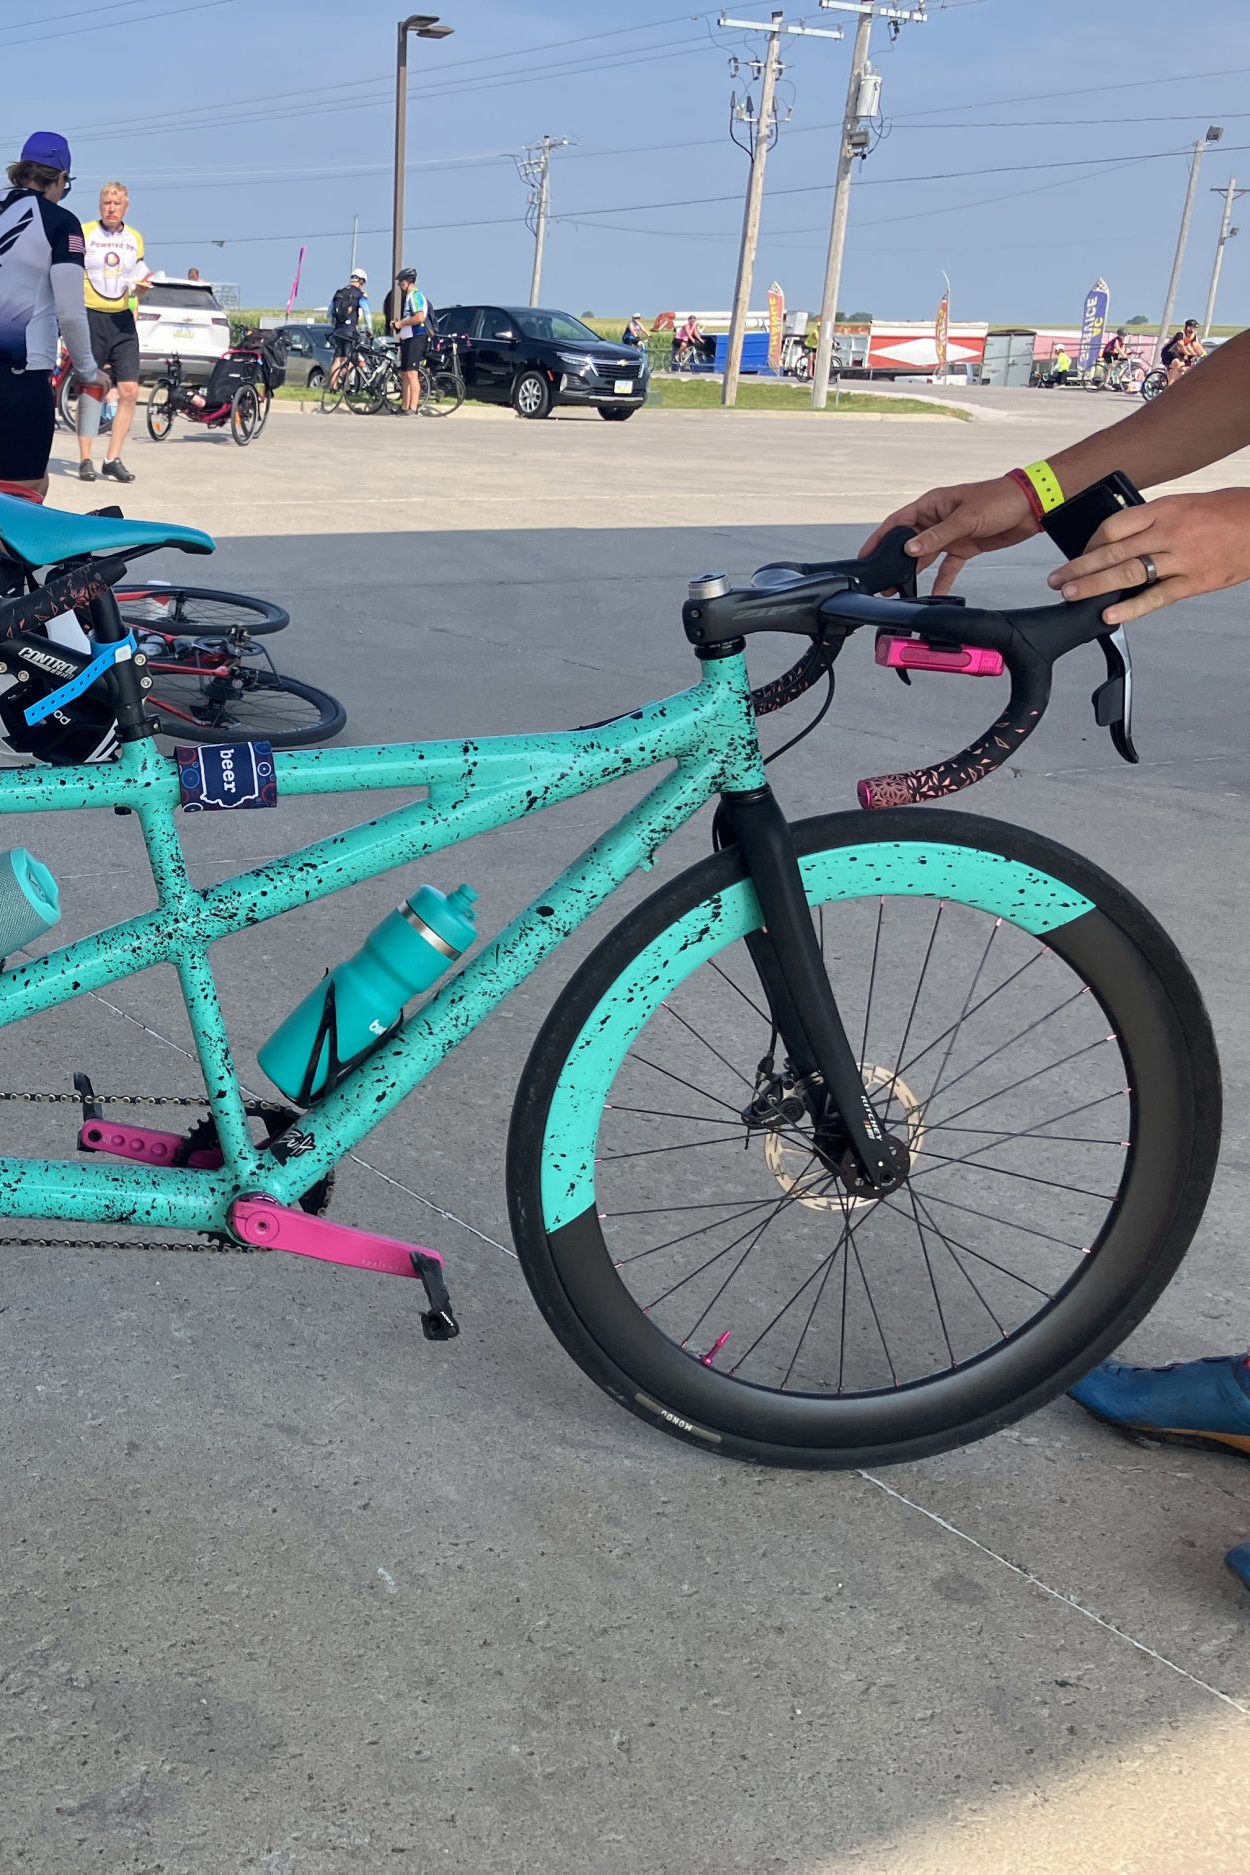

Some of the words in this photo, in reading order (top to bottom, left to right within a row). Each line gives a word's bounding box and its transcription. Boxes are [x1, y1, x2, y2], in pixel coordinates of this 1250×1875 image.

[90, 240, 124, 249] Powered
[17, 647, 79, 675] CONTROL
[219, 748, 237, 794] beer
[860, 1095, 883, 1142] RITCHEY
